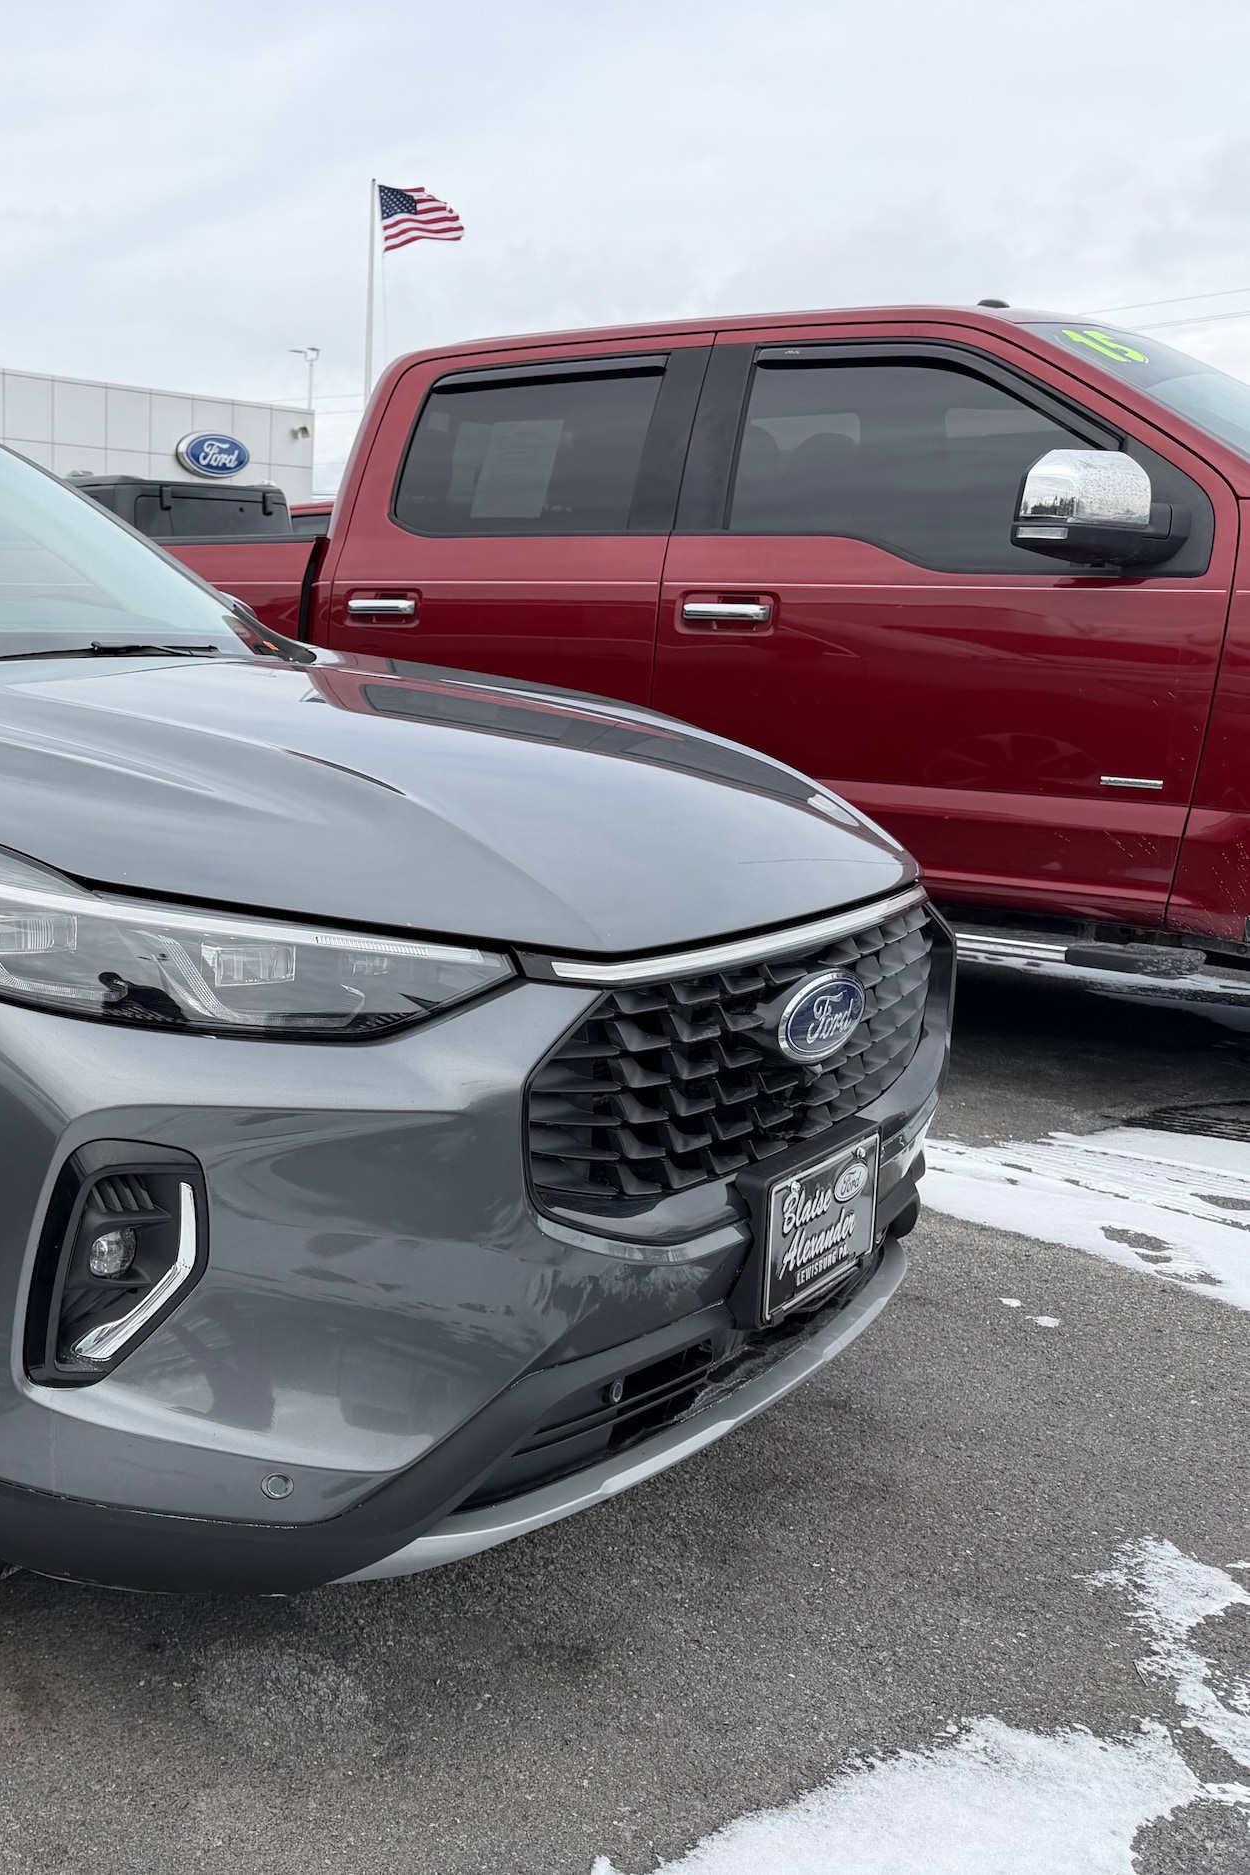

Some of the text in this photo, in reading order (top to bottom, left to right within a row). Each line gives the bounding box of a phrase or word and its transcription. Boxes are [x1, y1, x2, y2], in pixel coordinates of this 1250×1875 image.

[1061, 329, 1149, 364] 15
[198, 440, 239, 468] Ford
[806, 989, 854, 1045] Ford
[840, 1171, 862, 1197] Ford
[782, 1187, 833, 1235] Blaise
[778, 1208, 856, 1281] Alexander
[795, 1253, 838, 1287] LEWISBURG
